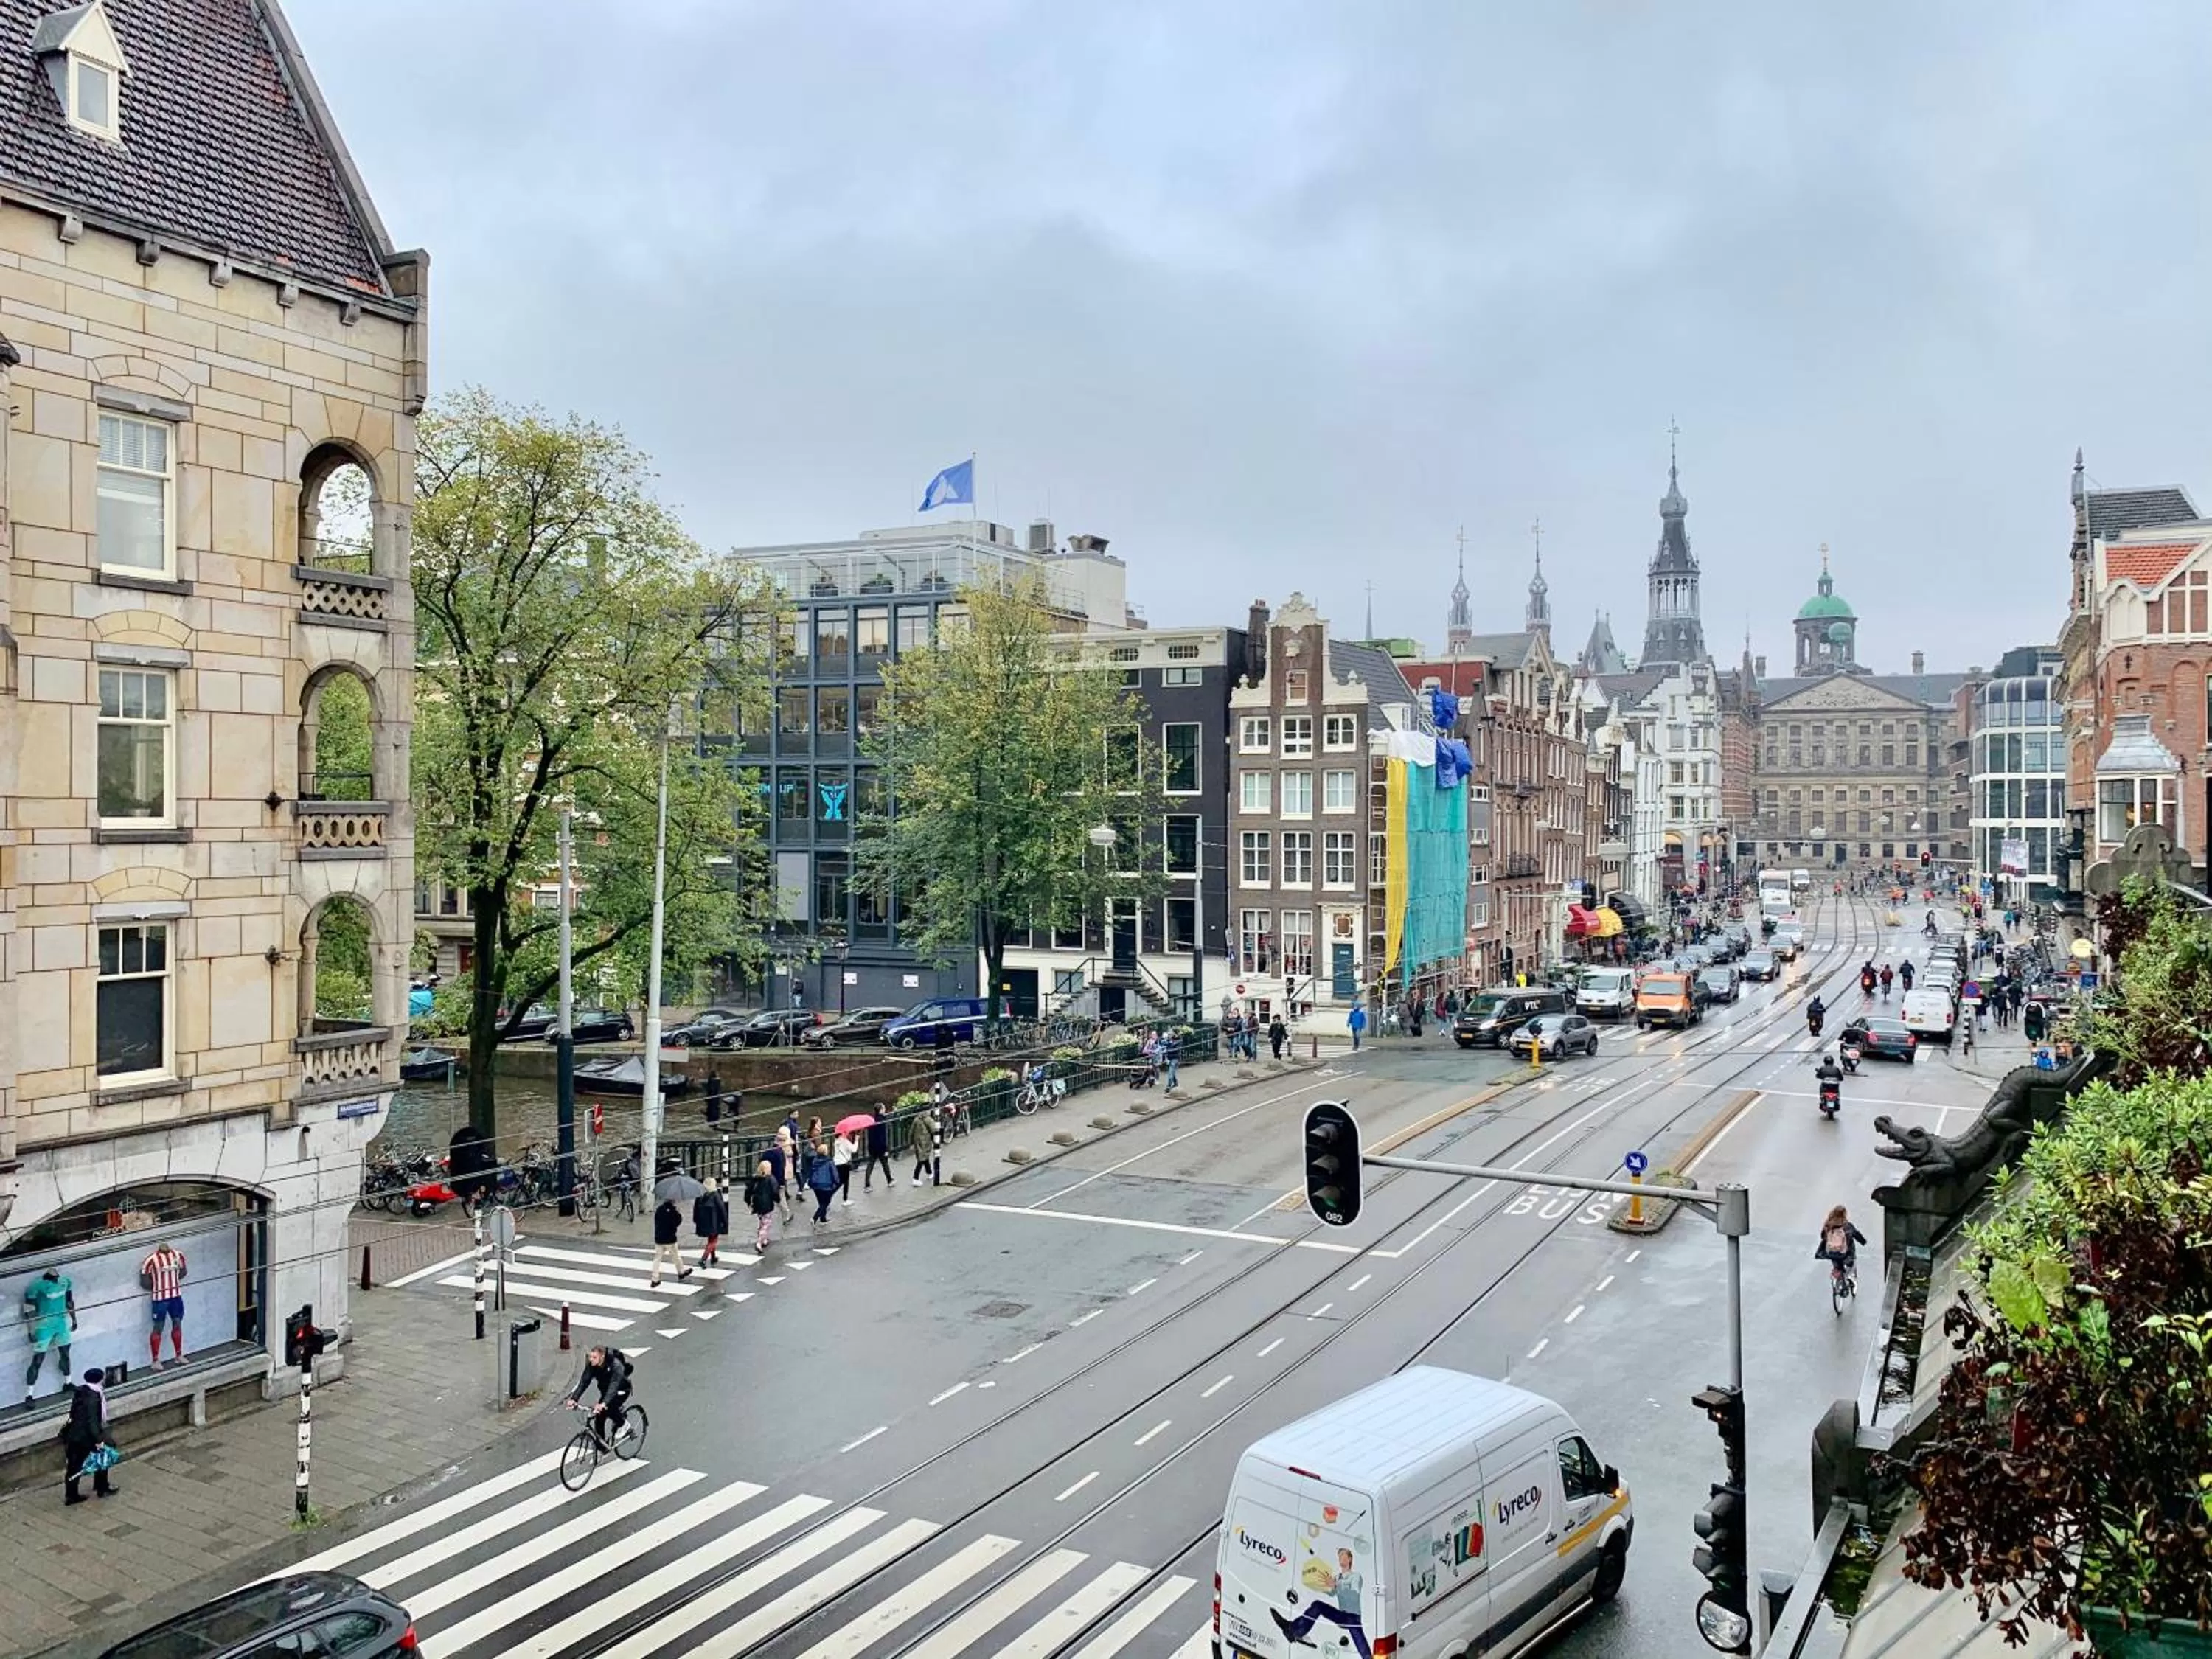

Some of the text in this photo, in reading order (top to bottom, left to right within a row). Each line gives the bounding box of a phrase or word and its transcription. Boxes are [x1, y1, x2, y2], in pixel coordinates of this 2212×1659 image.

[1503, 1194, 1611, 1225] BUS
[1498, 1485, 1538, 1526] Lyreco
[1239, 1529, 1283, 1560] Lyreco
